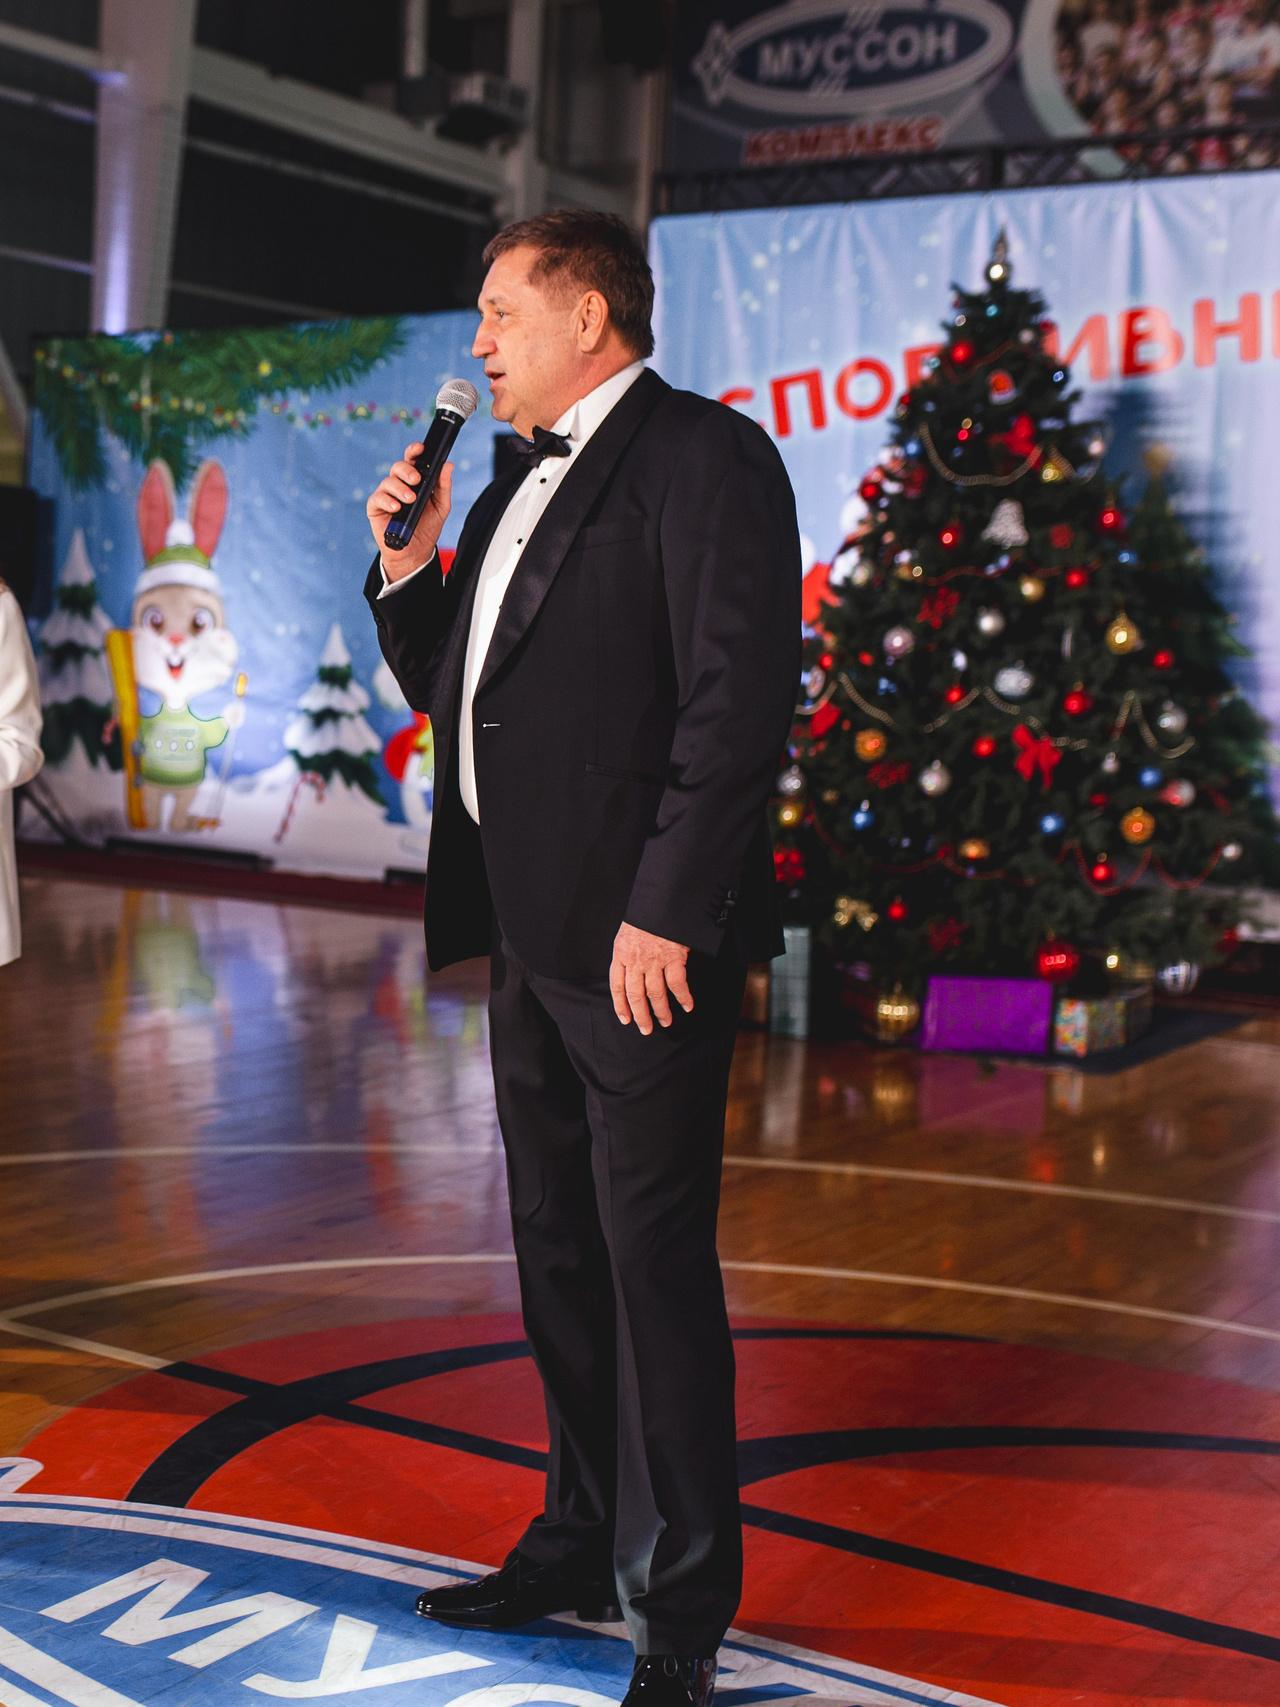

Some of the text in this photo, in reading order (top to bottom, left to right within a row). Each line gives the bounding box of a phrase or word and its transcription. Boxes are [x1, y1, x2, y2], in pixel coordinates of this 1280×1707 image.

[757, 21, 959, 81] МУССОН
[743, 116, 944, 166] КОМПЛЕКС
[37, 1558, 626, 1707] МУ
